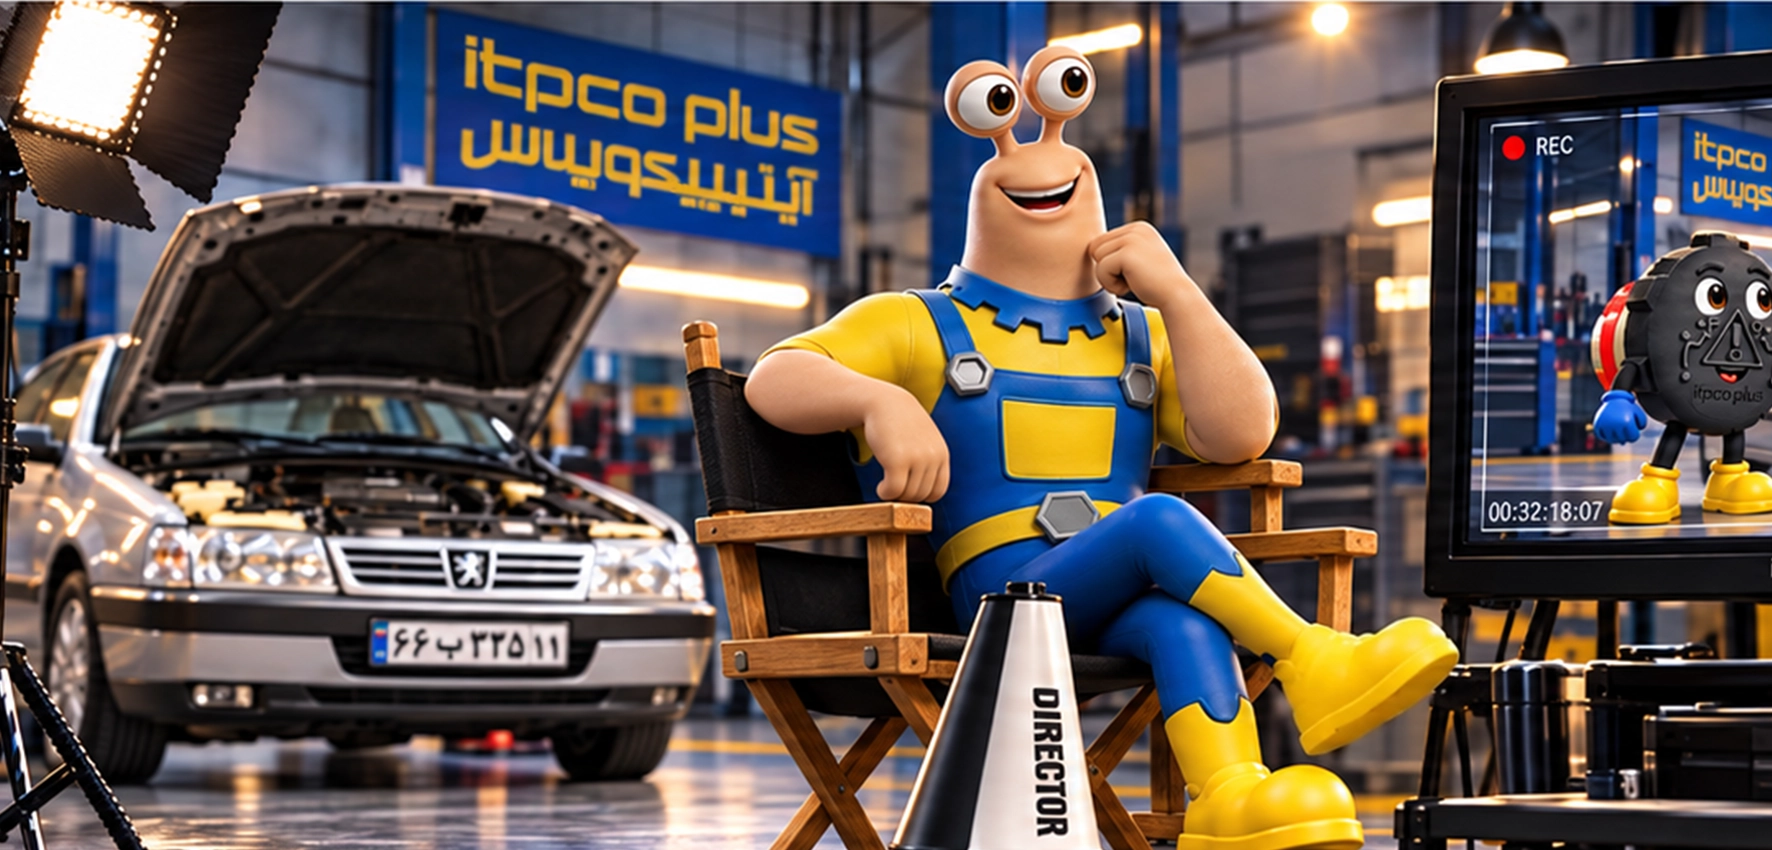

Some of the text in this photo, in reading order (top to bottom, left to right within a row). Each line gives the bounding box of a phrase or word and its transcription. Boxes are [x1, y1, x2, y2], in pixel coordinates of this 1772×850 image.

[464, 34, 819, 155] itpco plus
[1535, 135, 1574, 156] REC
[1693, 131, 1767, 172] itpco
[1488, 501, 1604, 523] 00:32:18:07
[1032, 687, 1068, 837] DIRECTOR
